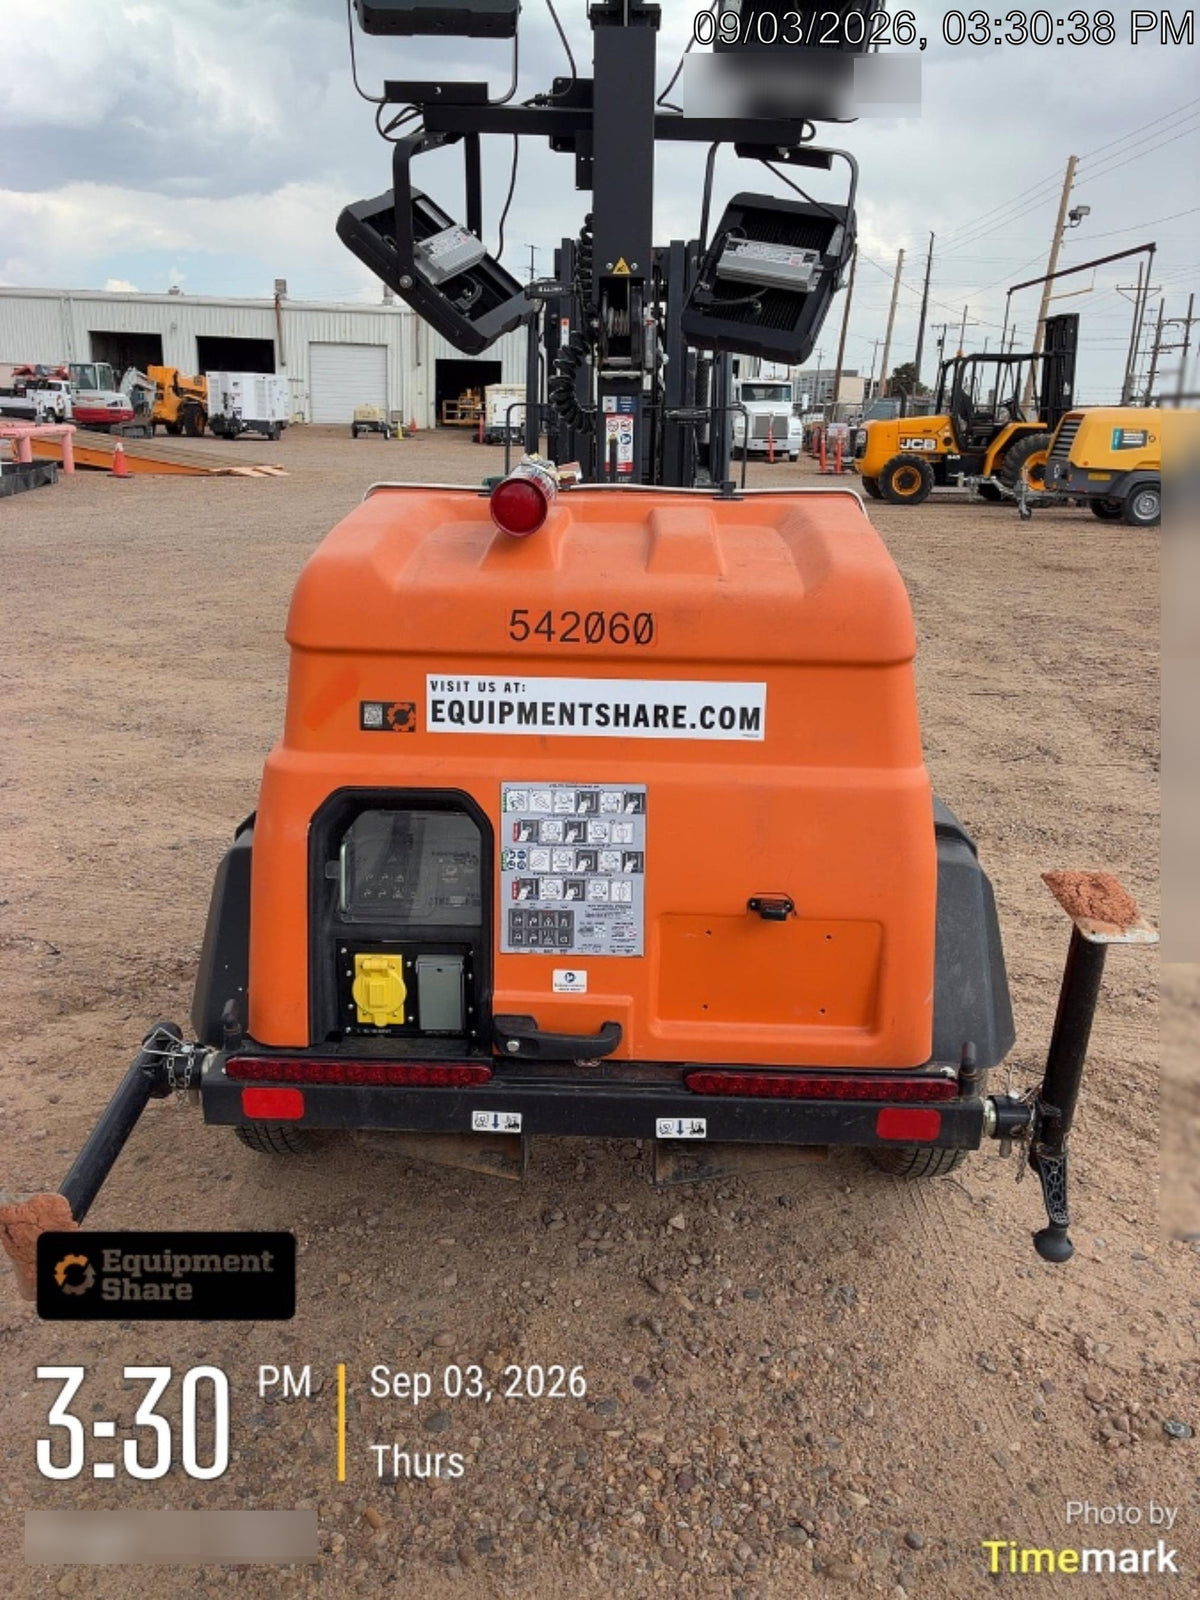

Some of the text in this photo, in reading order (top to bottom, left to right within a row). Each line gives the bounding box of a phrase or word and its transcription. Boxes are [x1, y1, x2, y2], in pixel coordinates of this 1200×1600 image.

[900, 438, 936, 450] JCB
[509, 609, 654, 645] 542060
[430, 680, 526, 693] VISIT US AT:
[431, 699, 761, 731] EQUIPMENTSHARE.COM
